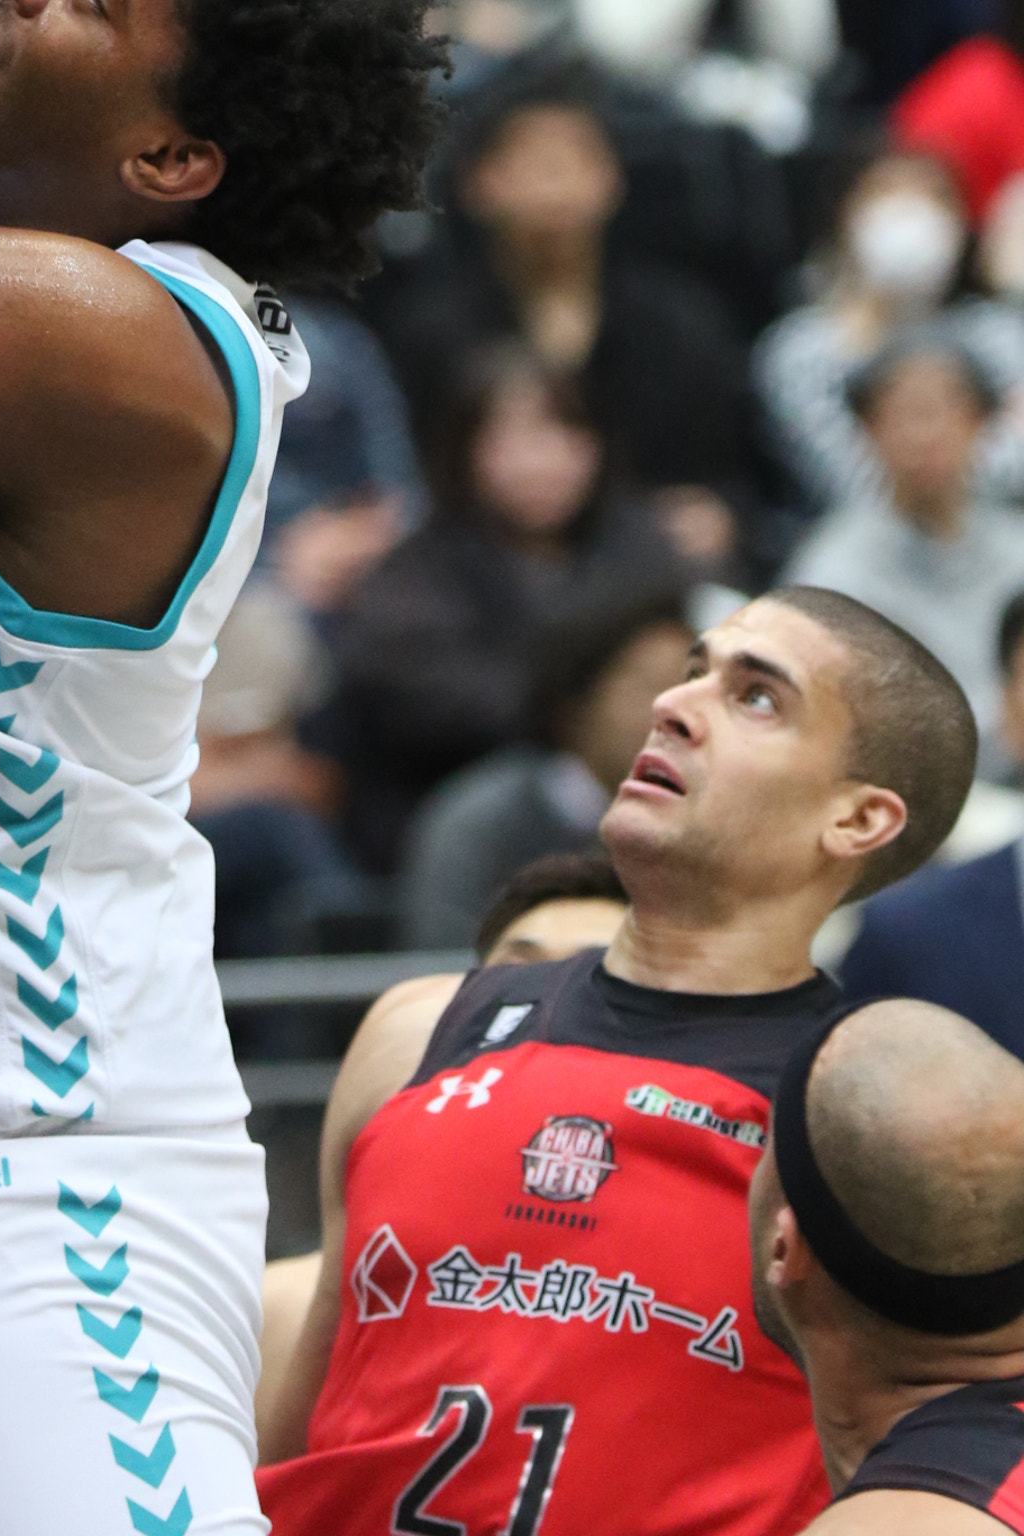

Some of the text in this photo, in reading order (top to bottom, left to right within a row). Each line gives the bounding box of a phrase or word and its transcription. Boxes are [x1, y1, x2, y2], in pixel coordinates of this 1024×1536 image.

[524, 1152, 602, 1196] JETS
[538, 1125, 606, 1162] CHIBA
[427, 1245, 744, 1371] 金太郎ホーム
[390, 1384, 575, 1536] 21
